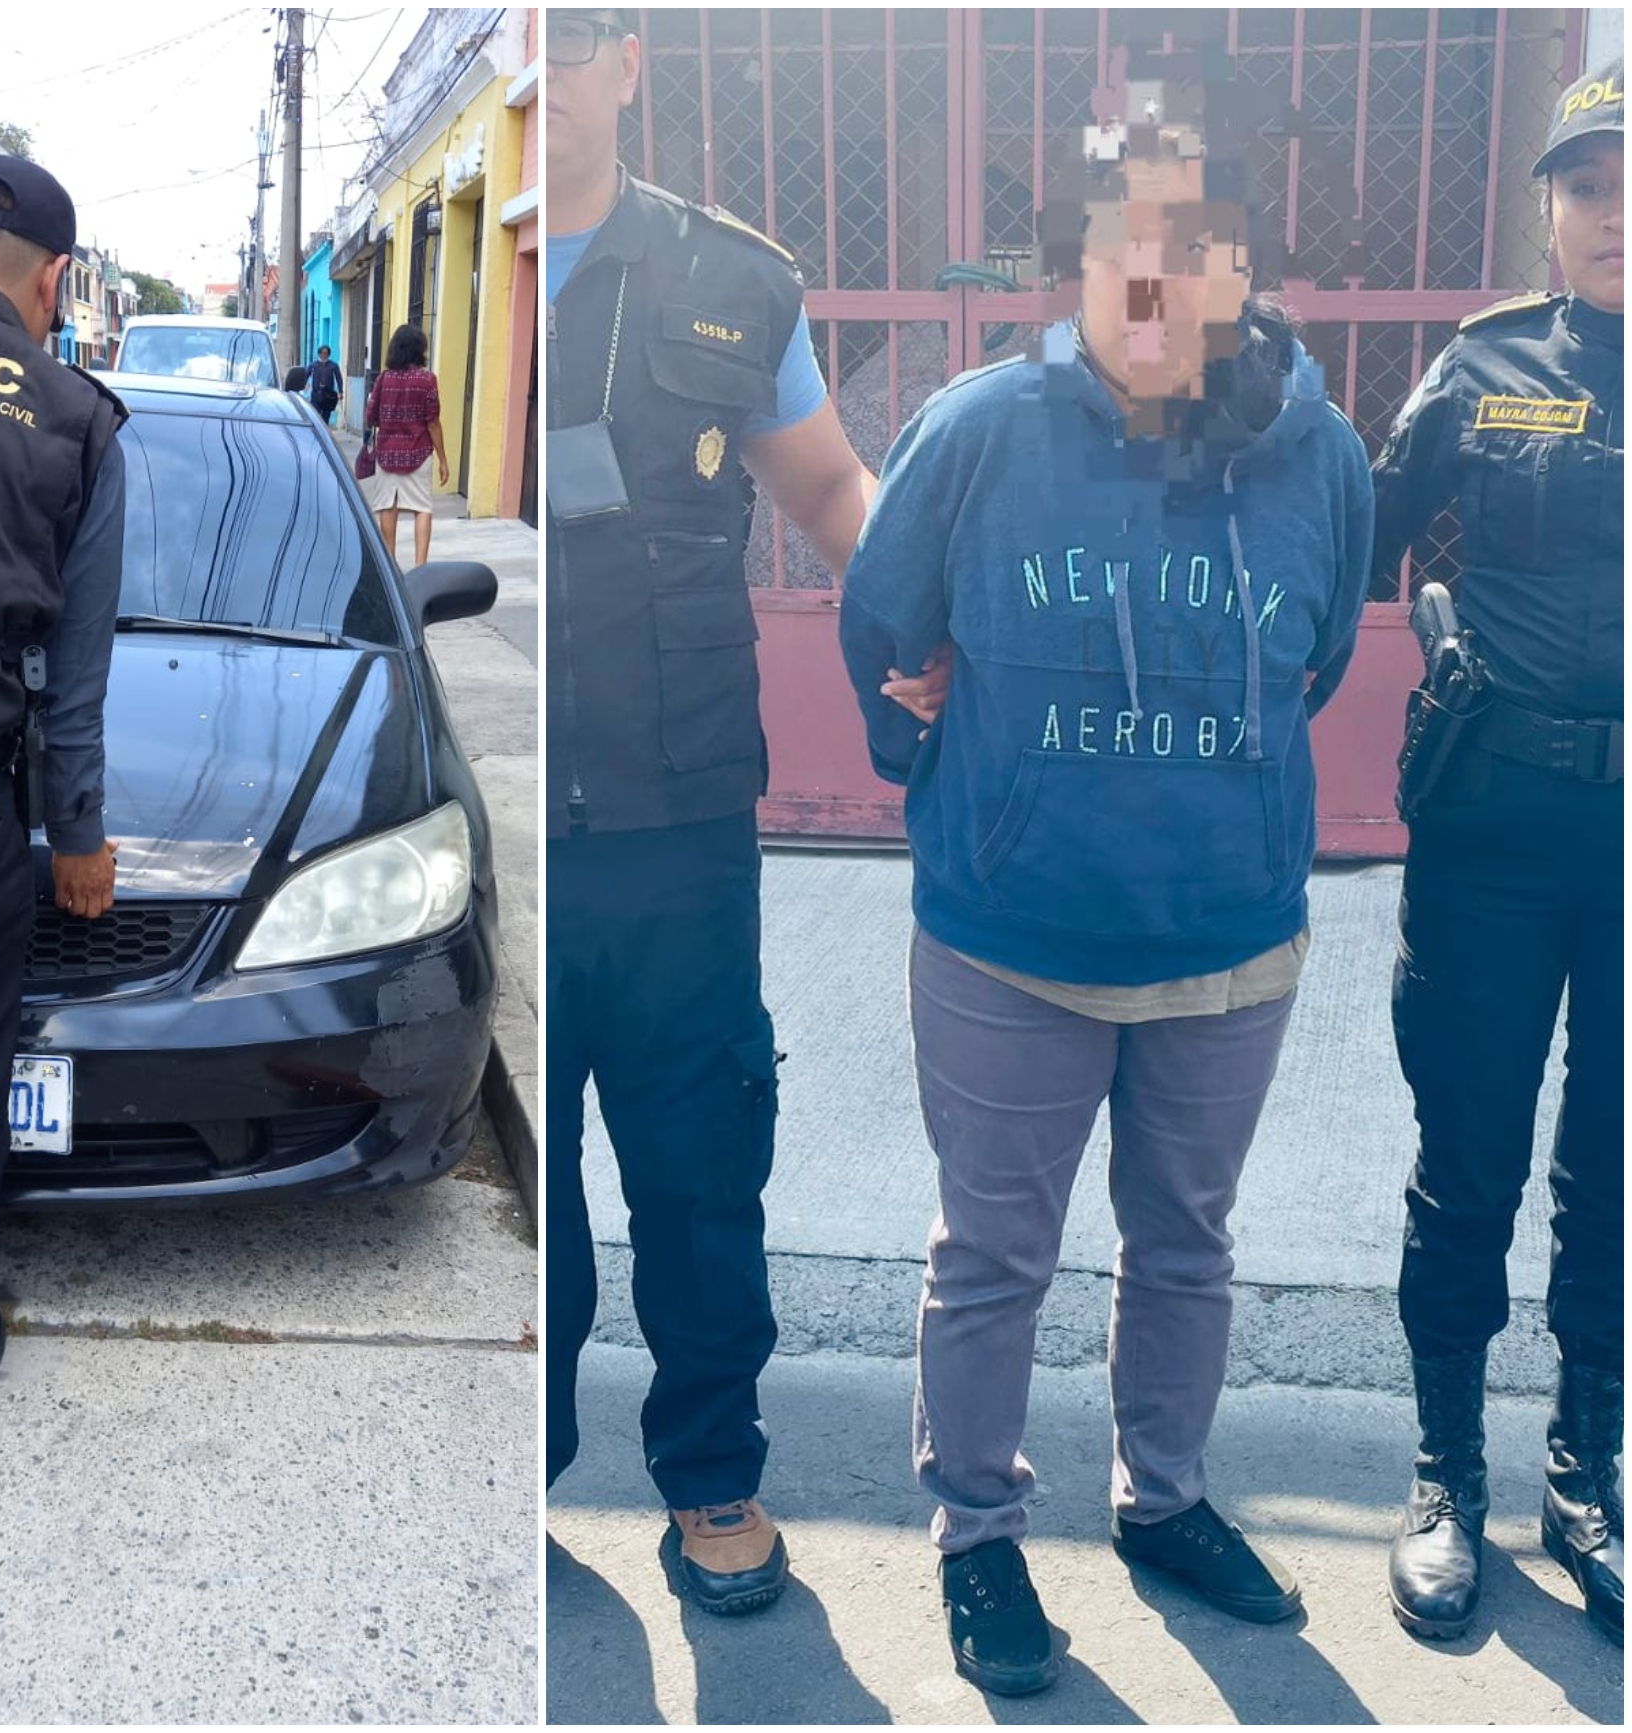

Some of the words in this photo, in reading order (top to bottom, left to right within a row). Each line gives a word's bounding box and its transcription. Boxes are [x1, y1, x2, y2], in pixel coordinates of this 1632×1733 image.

[1562, 77, 1624, 123] POL
[1042, 704, 1173, 756] AERO
[1199, 716, 1248, 757] 87
